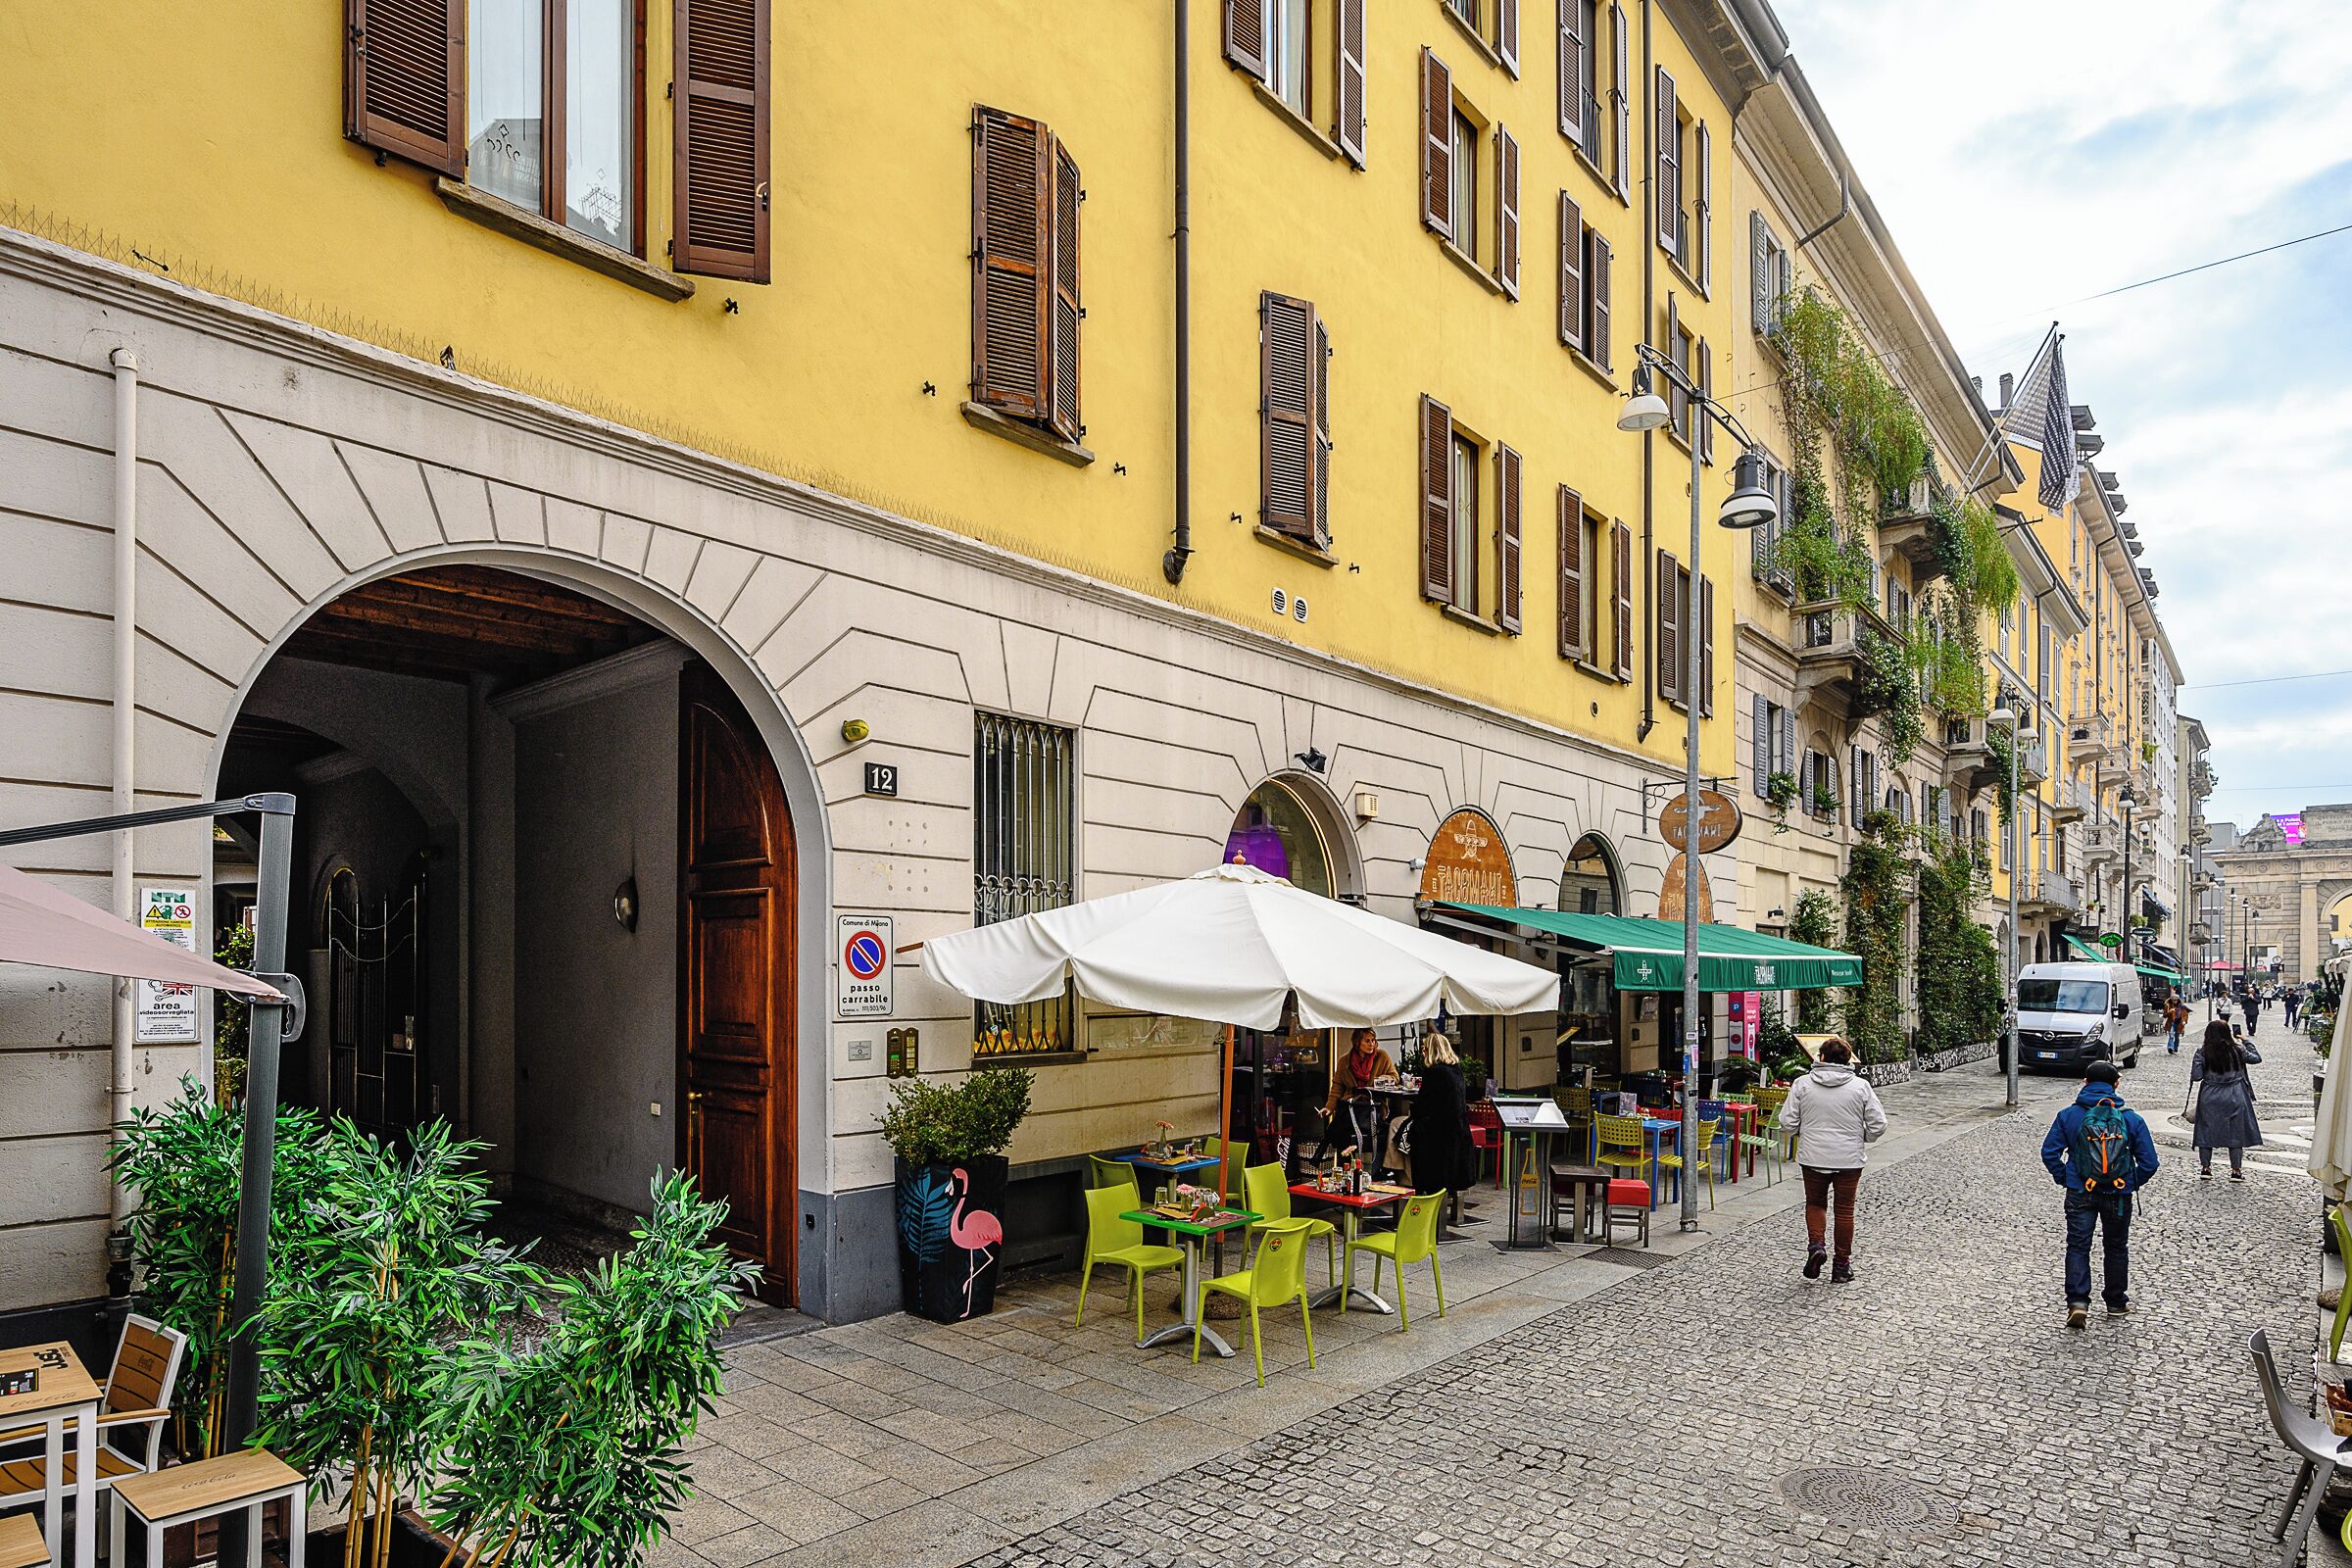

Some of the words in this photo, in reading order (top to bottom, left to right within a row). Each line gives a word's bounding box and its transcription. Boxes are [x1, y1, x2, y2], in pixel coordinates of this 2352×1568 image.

[871, 767, 893, 791] 12
[850, 984, 881, 994] passo
[842, 994, 889, 1004] carrabile
